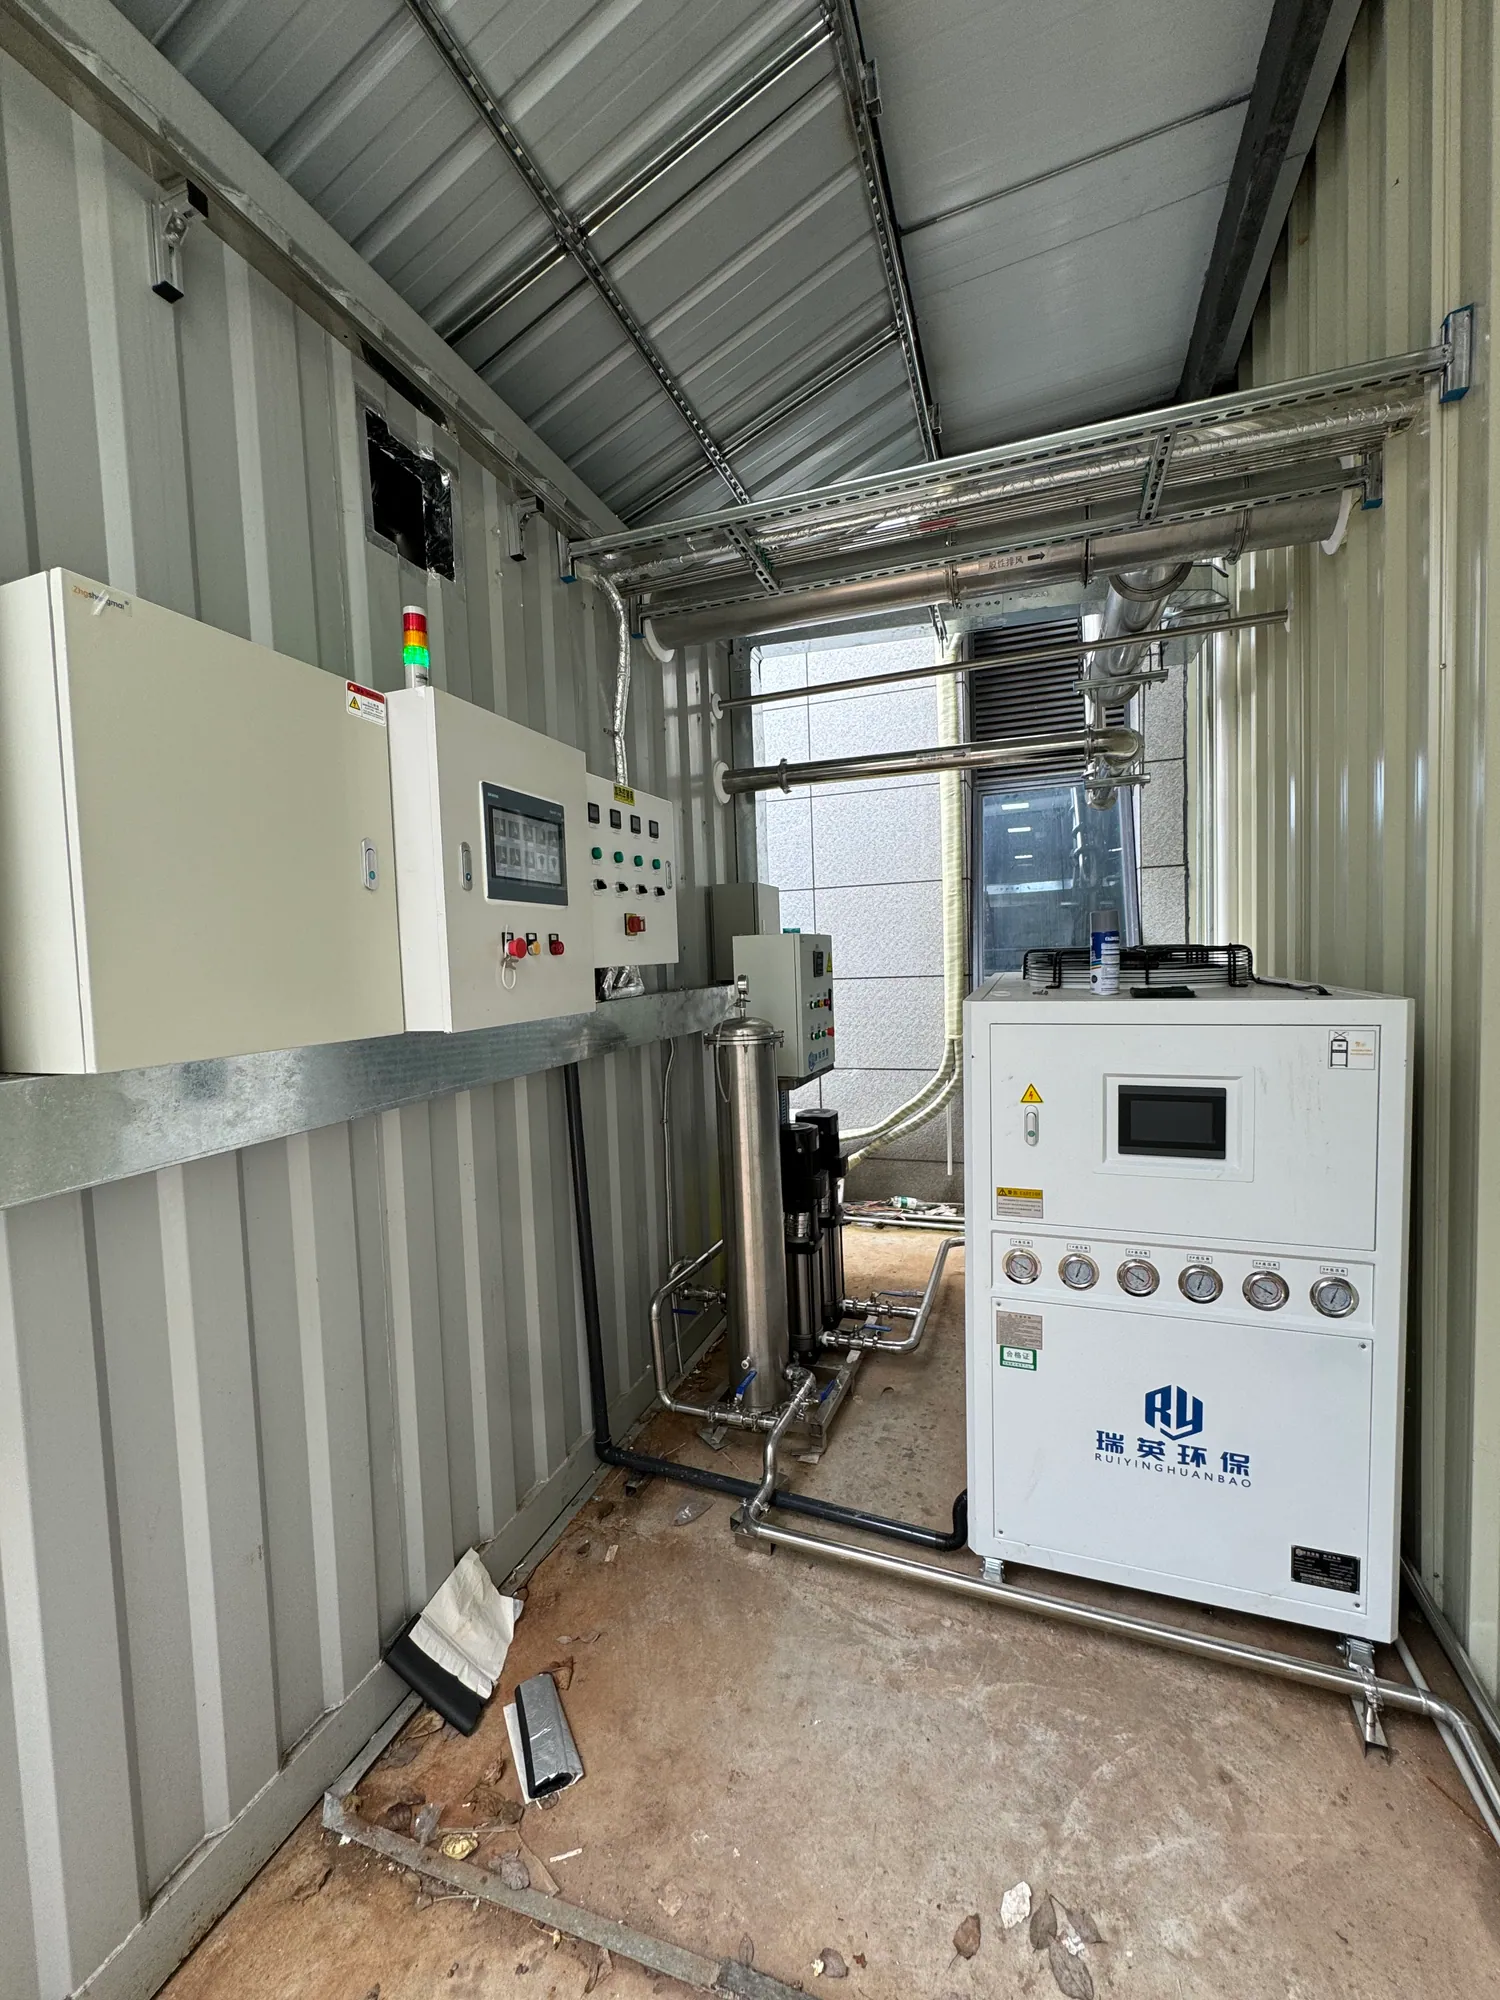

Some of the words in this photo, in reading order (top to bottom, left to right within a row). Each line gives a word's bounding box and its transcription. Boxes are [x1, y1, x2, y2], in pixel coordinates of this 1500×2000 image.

[1006, 1350, 1030, 1361] 合格证
[1094, 1452, 1252, 1488] RUIYINGHUANBAO
[1096, 1430, 1250, 1477] 瑞英环保
